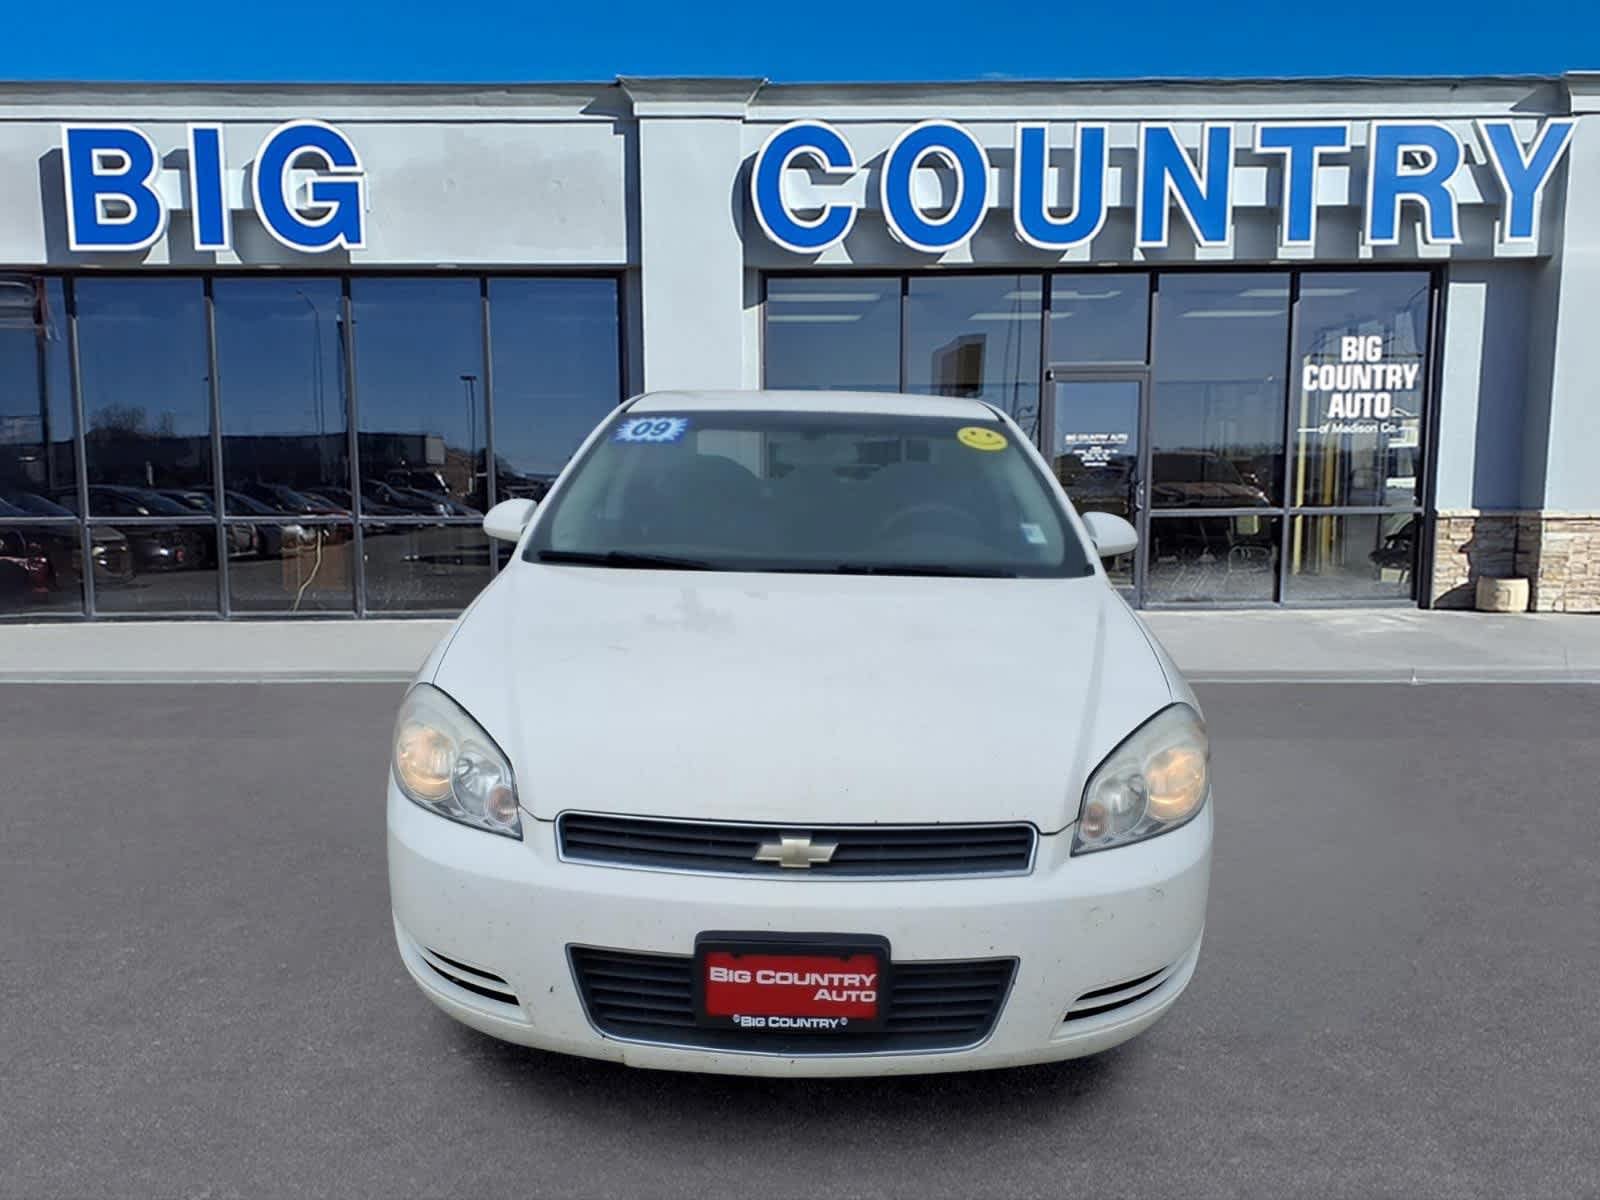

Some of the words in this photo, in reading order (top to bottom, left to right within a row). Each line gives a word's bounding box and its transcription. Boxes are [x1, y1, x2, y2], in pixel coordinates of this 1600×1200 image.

[60, 119, 367, 253] BIG
[750, 118, 1575, 254] COUNTRY
[1341, 336, 1382, 362] BIG
[1302, 363, 1419, 391] COUNTRY
[1327, 392, 1392, 419] AUTO
[631, 421, 672, 437] 09
[709, 966, 752, 983] BIG
[755, 970, 877, 987] COUNTRY
[813, 989, 876, 1003] AUTO
[740, 1015, 766, 1028] BIG
[768, 1016, 838, 1029] COUNTRY
